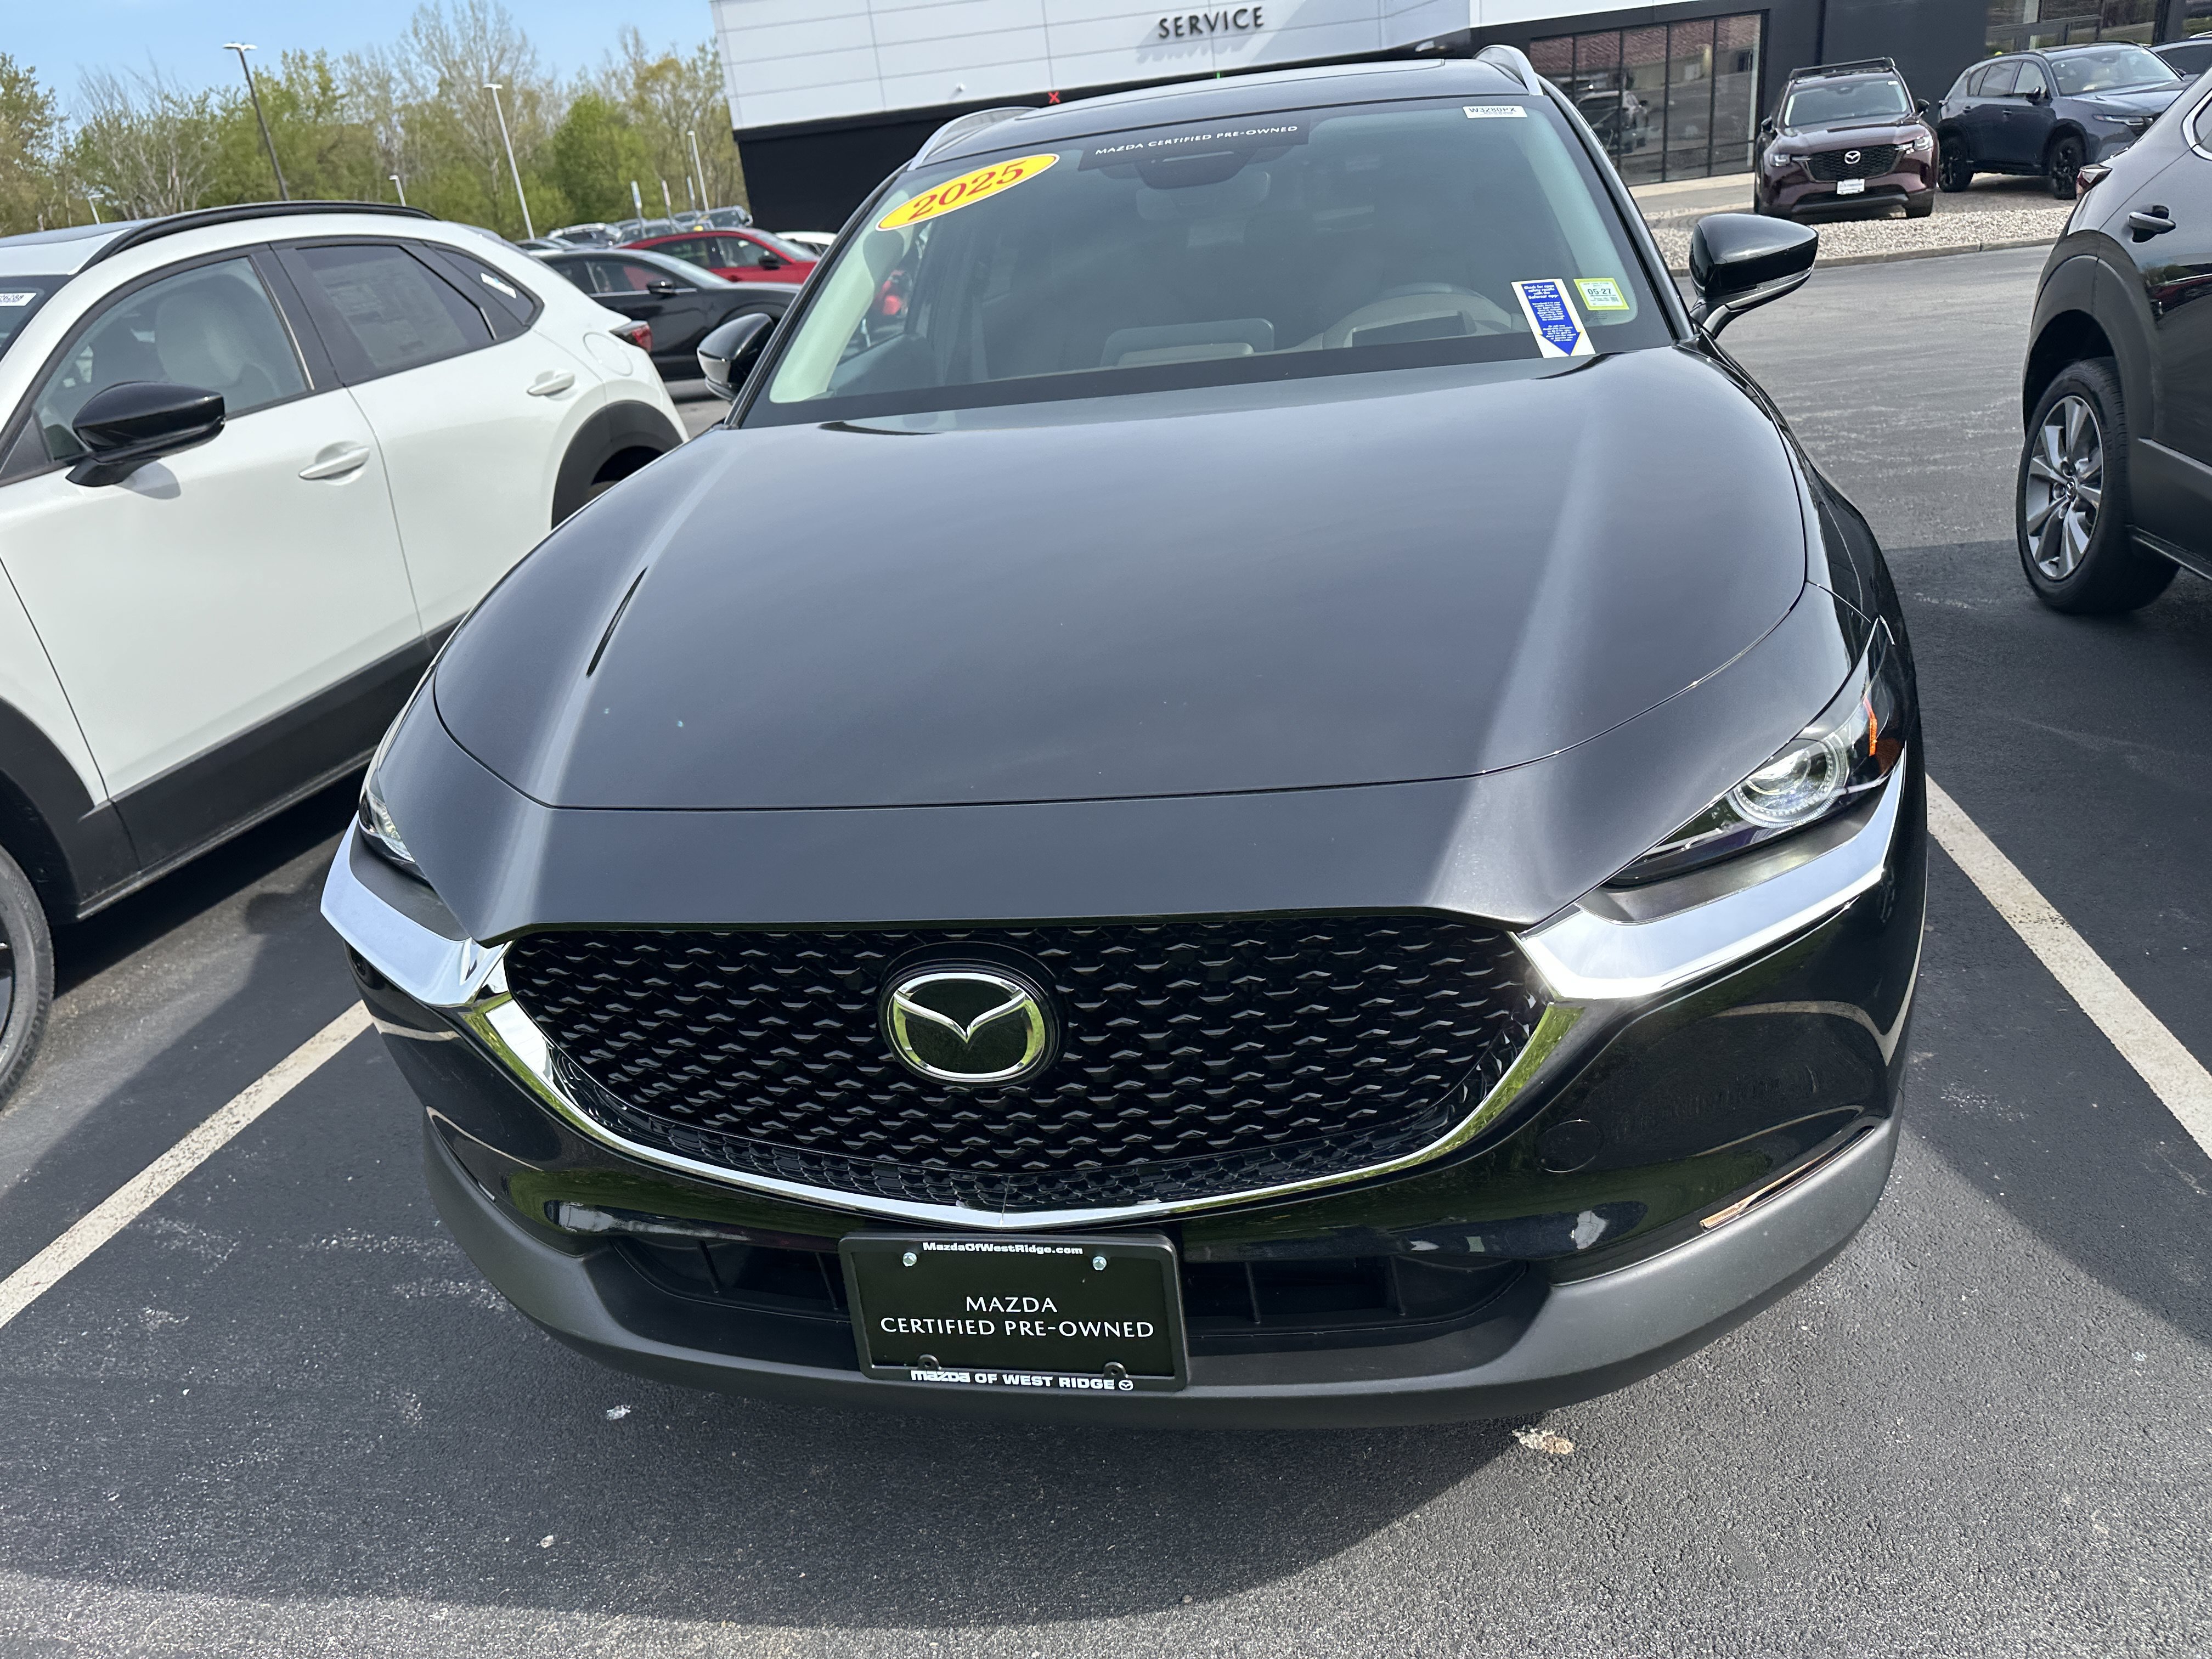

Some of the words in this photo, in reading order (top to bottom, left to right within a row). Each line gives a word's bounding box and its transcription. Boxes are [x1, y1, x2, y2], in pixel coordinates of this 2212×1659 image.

[1158, 6, 1265, 40] SERVICE
[1095, 143, 1144, 155] MAZDA
[1148, 134, 1212, 147] CERTIFIED
[1216, 126, 1297, 139] PRE-OWNED
[907, 160, 1026, 221] 2025
[922, 1242, 1083, 1255] MazdaOfWestRidge.com
[966, 1296, 1058, 1313] MAZDA
[880, 1317, 995, 1335] CERTIFIED
[1005, 1320, 1154, 1338] PRE-OWNED
[974, 1373, 997, 1384] OF
[1002, 1374, 1053, 1387] WEST
[1058, 1377, 1115, 1390] RIDGE
